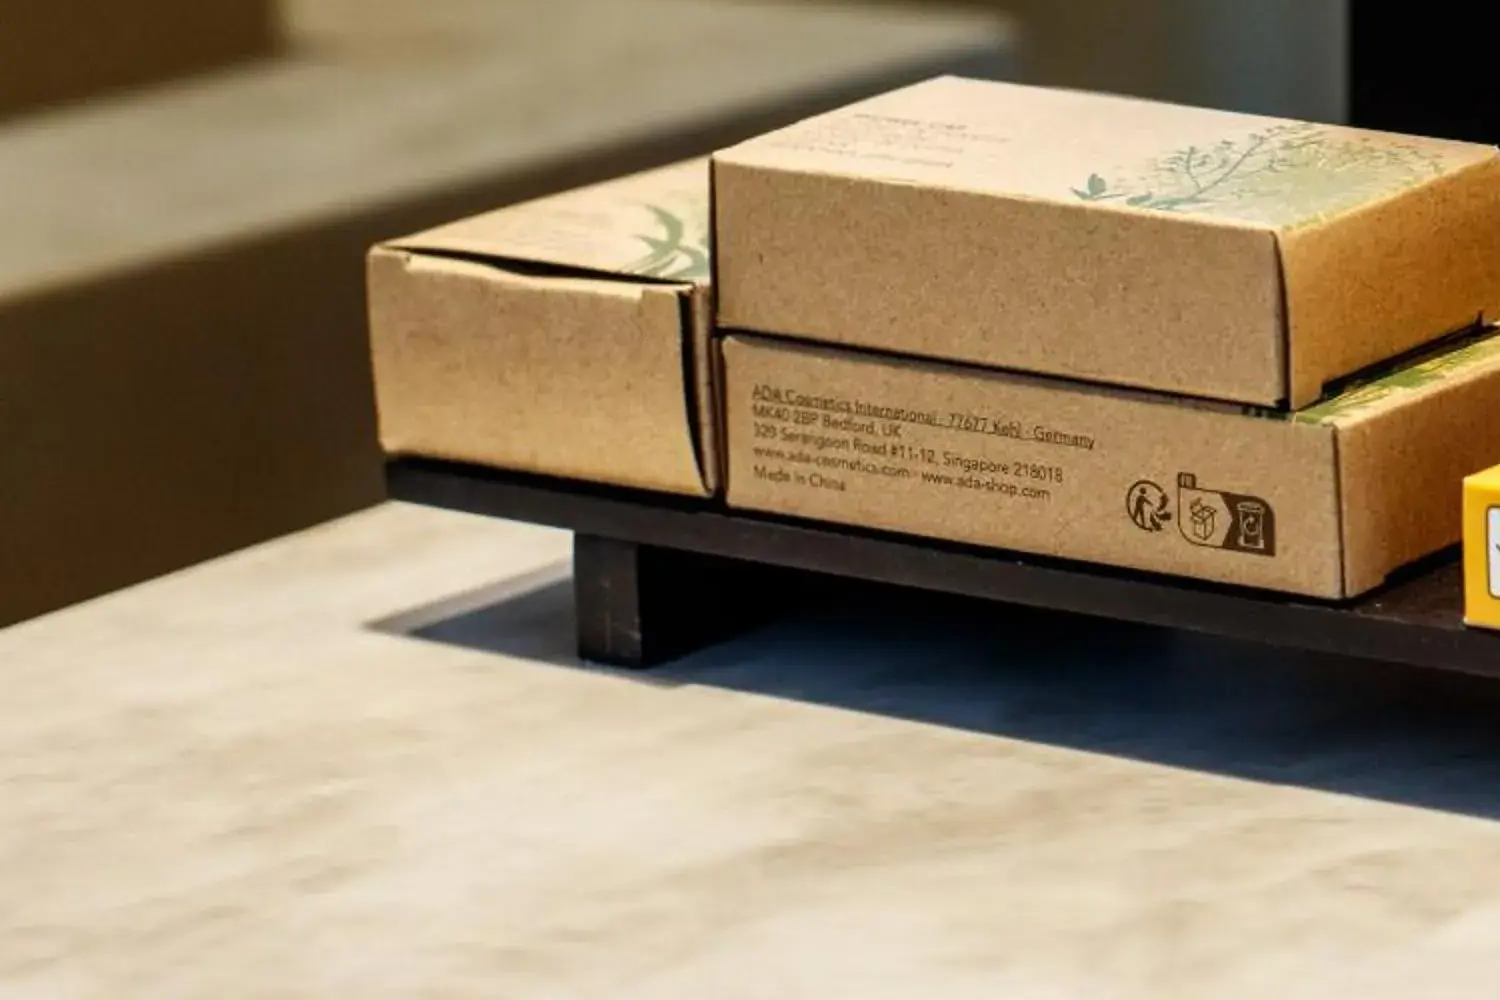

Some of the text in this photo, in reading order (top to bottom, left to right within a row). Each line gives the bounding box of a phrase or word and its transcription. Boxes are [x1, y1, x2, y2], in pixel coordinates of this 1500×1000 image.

[752, 384, 781, 402] ADA
[786, 389, 851, 412] Cosmetics
[855, 400, 936, 426] International
[1033, 425, 1095, 450] Germany
[882, 423, 901, 437] UK
[753, 464, 790, 482] Made
[853, 437, 887, 455] Road
[943, 451, 1009, 475] Singapore
[1013, 461, 1064, 483] 218018
